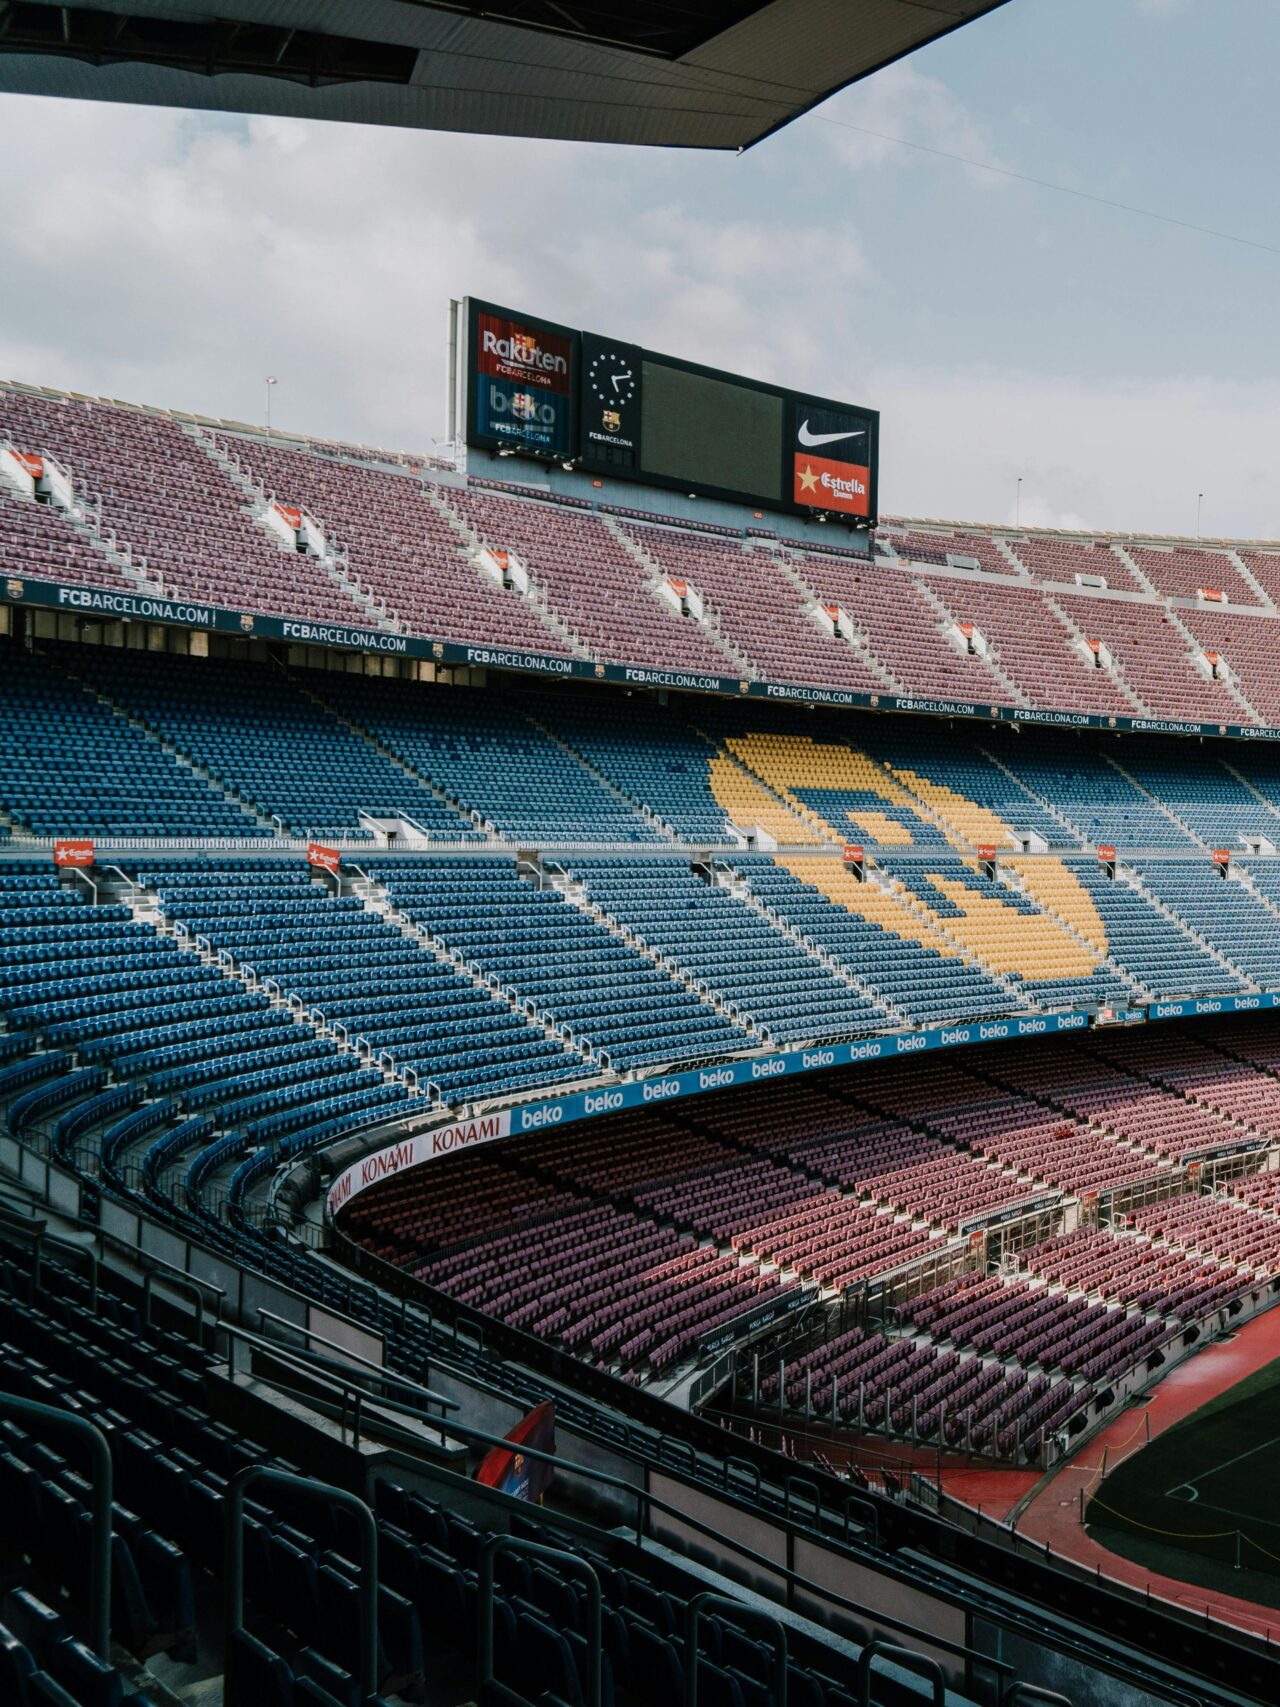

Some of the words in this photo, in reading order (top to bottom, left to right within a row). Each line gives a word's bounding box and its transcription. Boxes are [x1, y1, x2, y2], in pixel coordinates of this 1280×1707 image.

[483, 330, 567, 374] Rakuten
[589, 431, 633, 447] FCBARCELONA
[821, 471, 866, 495] Estrella
[59, 588, 209, 625] FCBARCELONA.COM
[283, 621, 407, 653] FCBARCELONA.COM
[467, 649, 573, 674] FCBARCELONA.COM
[626, 668, 720, 691] FCBARCELONA.COM
[767, 685, 853, 704] FCBARCELONA.COM
[896, 698, 975, 715] FCBARCELONA.COM
[1014, 710, 1090, 726] FCBARCELONA.COM
[1131, 720, 1202, 733] FCBARCELONA.COM
[1157, 1003, 1183, 1017] beko
[1196, 1000, 1222, 1013] beko
[1234, 996, 1260, 1009] beko
[1057, 1013, 1084, 1030] beko
[1125, 1010, 1143, 1021] beko
[980, 1021, 1008, 1039] beko
[1018, 1017, 1046, 1034] beko
[897, 1034, 926, 1053] beko
[941, 1028, 970, 1046] beko
[803, 1049, 835, 1069] beko
[850, 1041, 881, 1060] beko
[751, 1057, 786, 1079] beko
[699, 1068, 735, 1091] beko
[642, 1078, 680, 1102] beko
[584, 1090, 624, 1115] beko
[521, 1104, 562, 1130] beko
[433, 1116, 500, 1153] KONAMI
[361, 1143, 414, 1183] KONAMI
